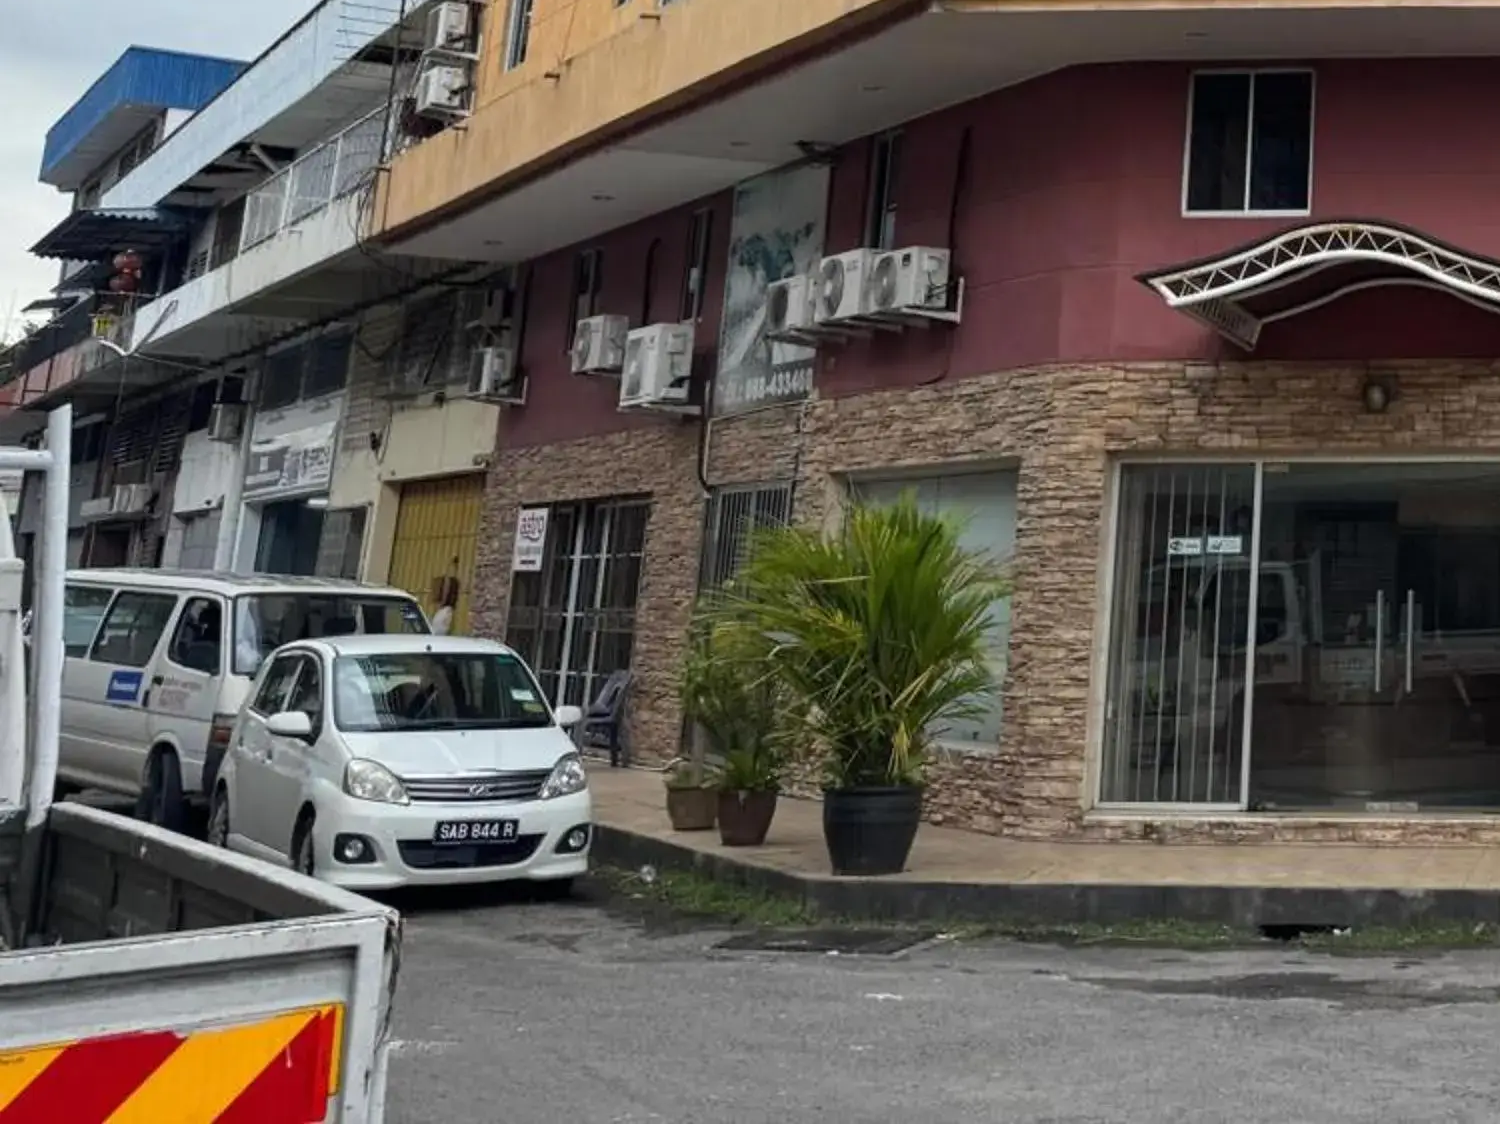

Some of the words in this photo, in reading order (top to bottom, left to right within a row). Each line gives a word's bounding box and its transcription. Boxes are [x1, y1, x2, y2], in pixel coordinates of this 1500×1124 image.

[440, 822, 469, 839] SAB
[471, 822, 499, 838] 844
[503, 821, 514, 837] R
